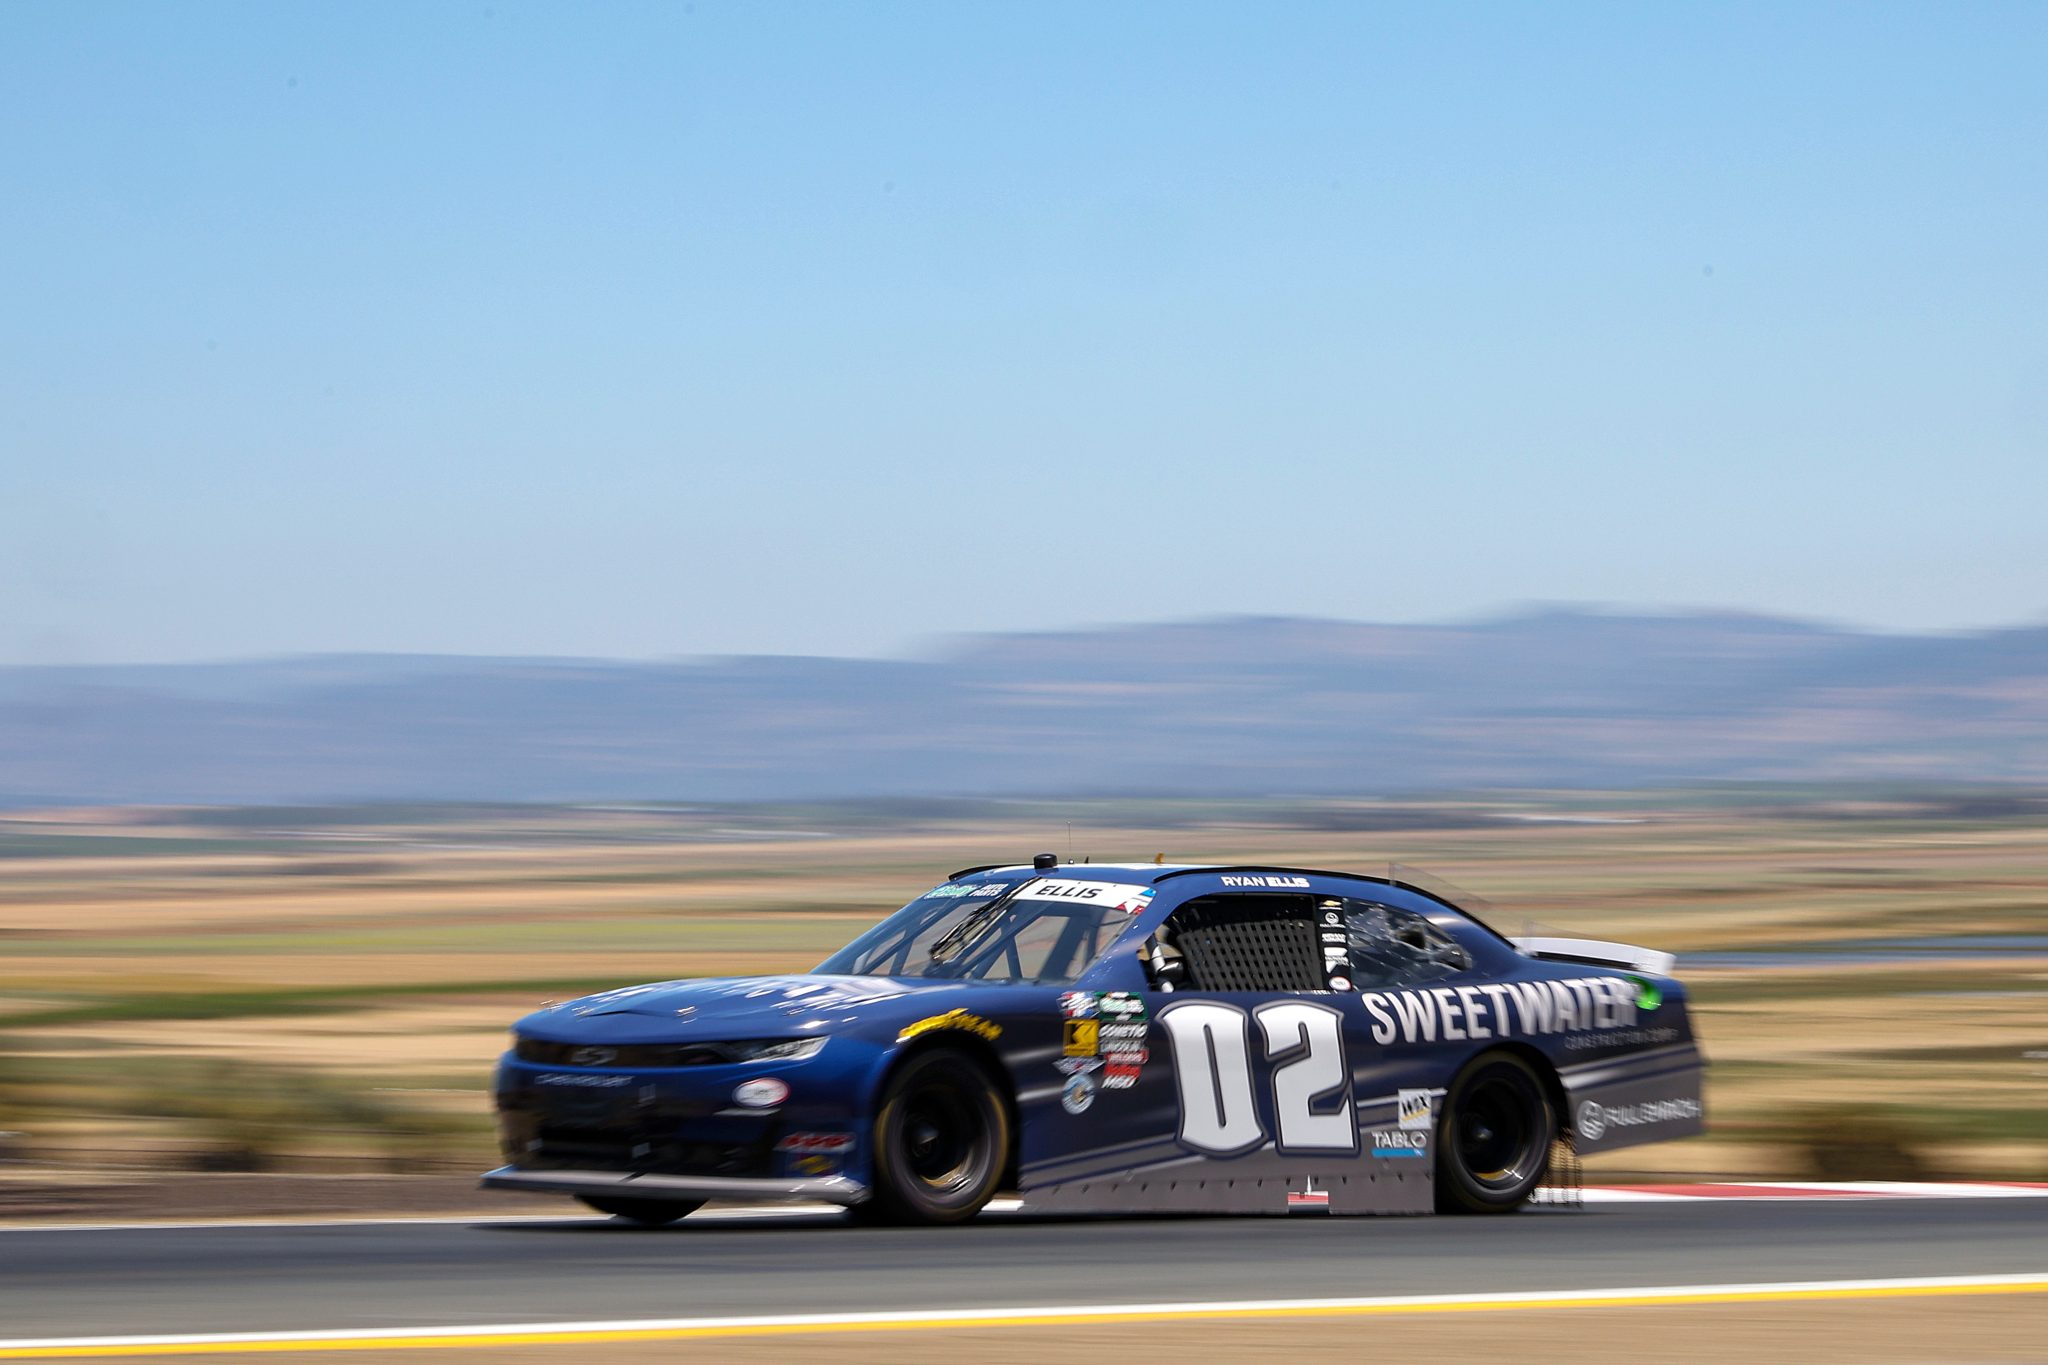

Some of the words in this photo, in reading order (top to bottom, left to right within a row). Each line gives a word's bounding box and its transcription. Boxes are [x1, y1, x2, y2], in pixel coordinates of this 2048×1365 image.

[1221, 876, 1265, 886] RYAN
[1265, 877, 1310, 888] ELLIS
[1036, 885, 1104, 899] ELLIS
[1361, 976, 1640, 1046] SWEETWATER
[1157, 1000, 1358, 1155] 02
[1371, 1131, 1427, 1148] TABLO
